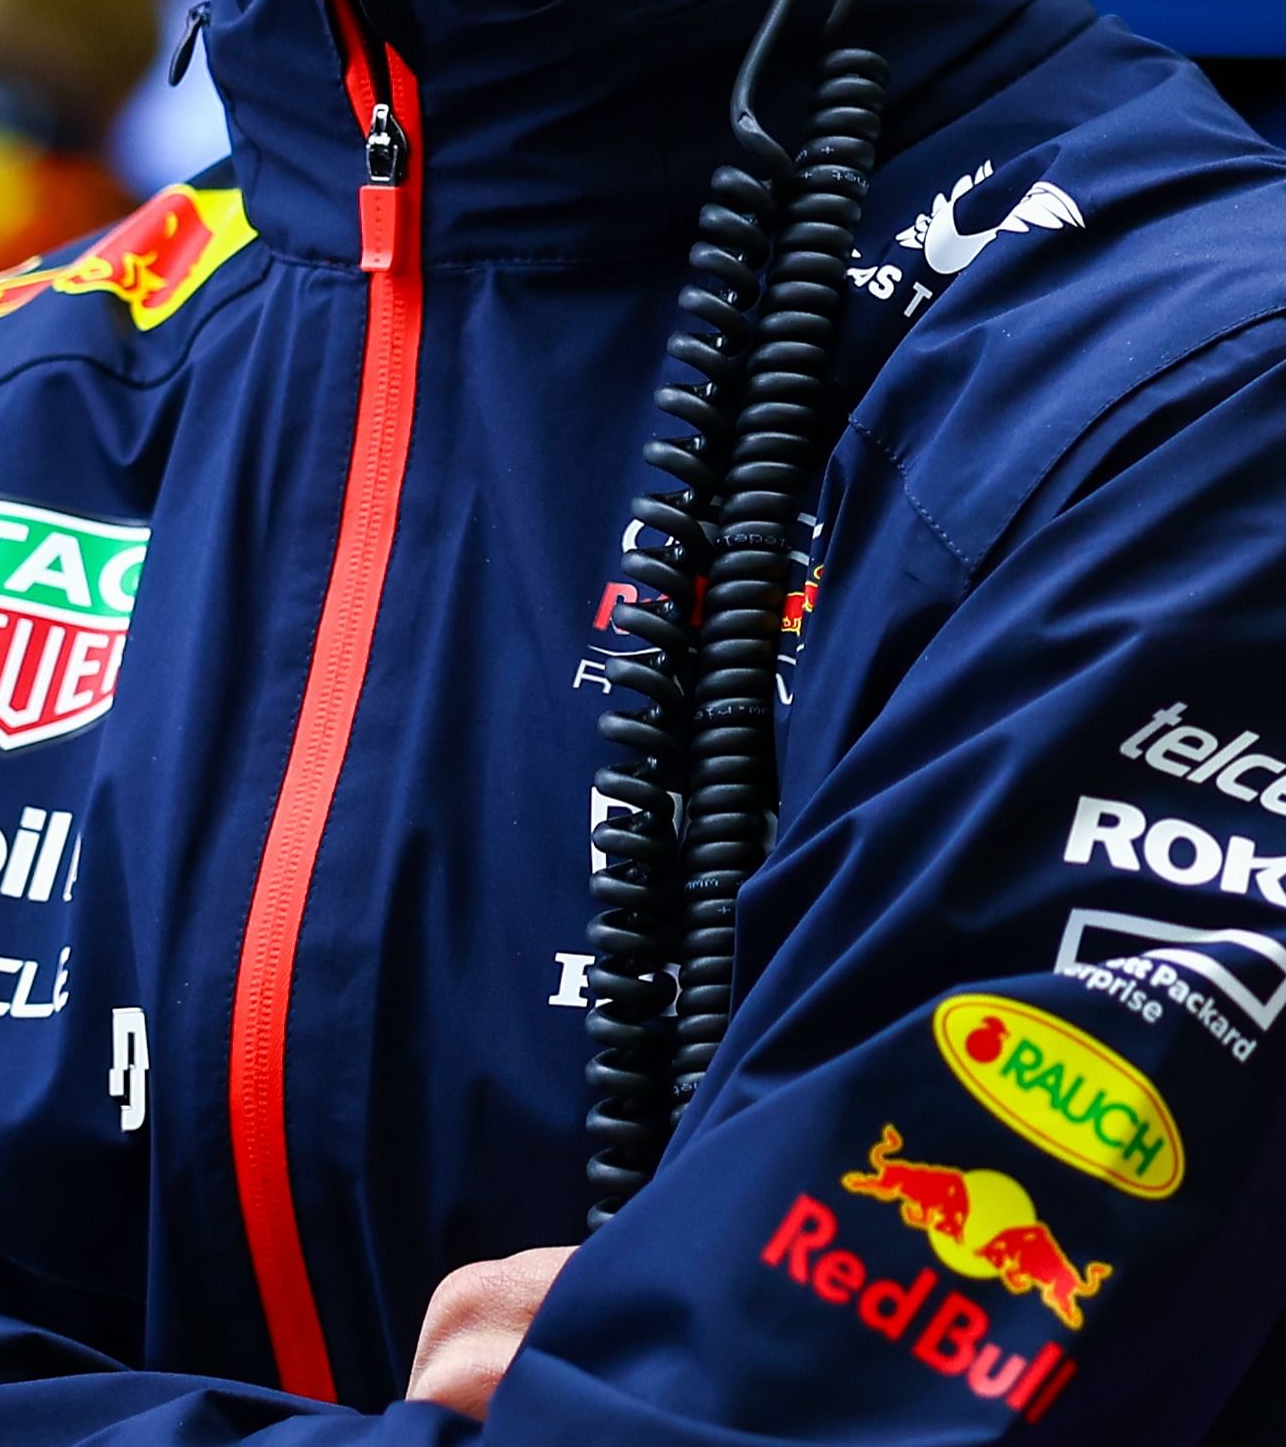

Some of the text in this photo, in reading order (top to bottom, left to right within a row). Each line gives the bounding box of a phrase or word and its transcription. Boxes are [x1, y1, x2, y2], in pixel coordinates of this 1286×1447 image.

[846, 264, 903, 300] AS
[1150, 964, 1259, 1063] Packard
[999, 1039, 1166, 1178] RAUCH
